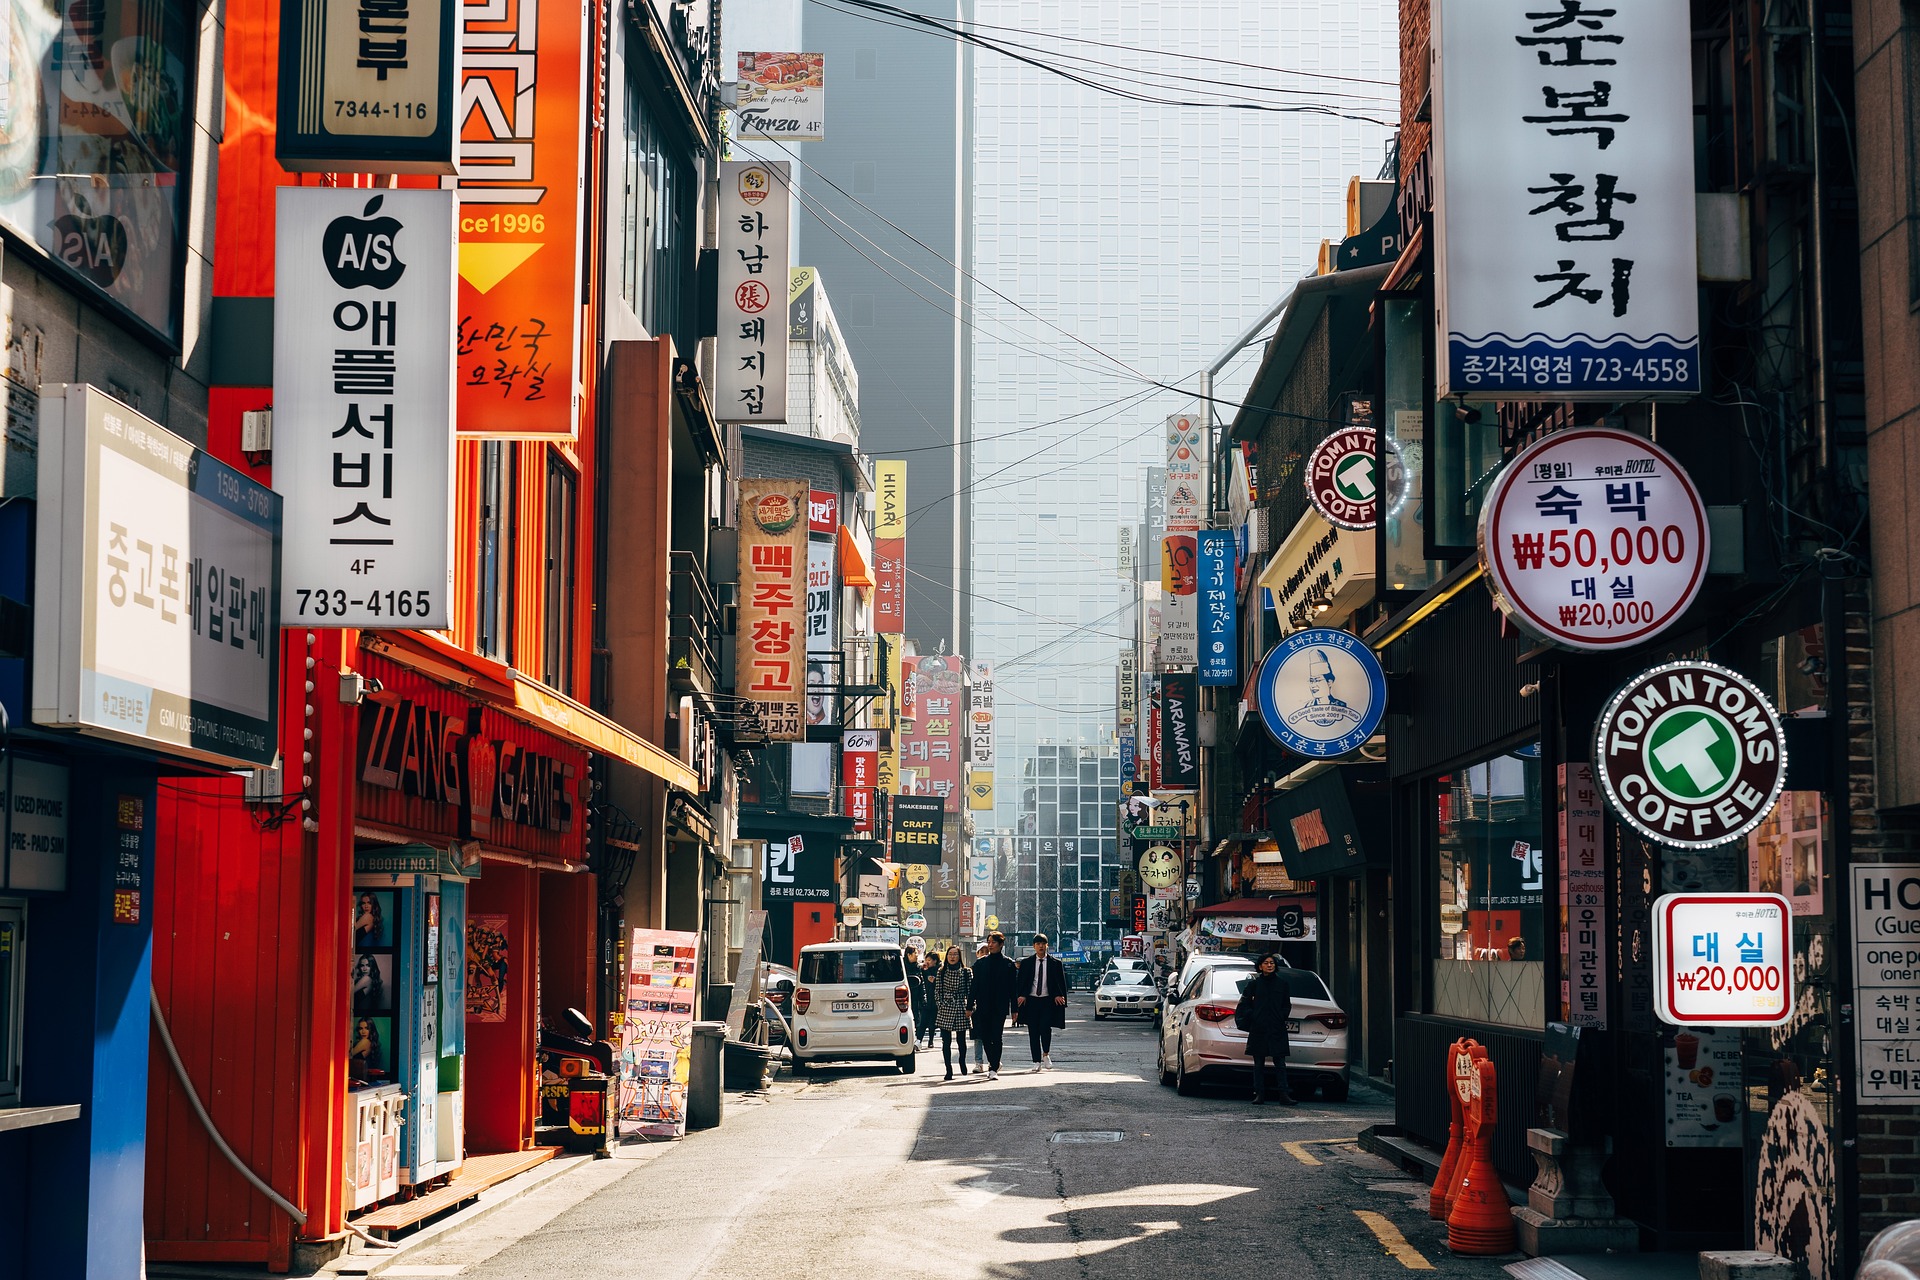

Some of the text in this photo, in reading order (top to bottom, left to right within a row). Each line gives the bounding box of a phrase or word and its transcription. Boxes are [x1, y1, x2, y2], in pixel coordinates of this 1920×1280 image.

[334, 100, 427, 120] 7344-116
[740, 107, 822, 132] Forza 4F
[1515, 0, 1637, 318] 춘복참치
[460, 214, 545, 235] ce1996
[337, 232, 394, 271] A/S
[457, 316, 552, 366] 한민국
[1462, 355, 1689, 385] 종각직영점 723-4558
[329, 299, 397, 546] 애플서비스
[1315, 434, 1361, 481] TOM N
[1534, 458, 1656, 479] [평일] 우미관 HOTEL
[217, 470, 269, 519] 1599 3768
[883, 473, 896, 527] HIKARI
[1176, 506, 1190, 515] 4F
[1511, 524, 1685, 574] ₩50,000
[350, 559, 375, 576] 4F
[296, 589, 431, 618] 733-4165
[750, 545, 795, 692] 맥주창고
[1558, 600, 1654, 629] ₩20,000
[1326, 632, 1355, 650] 전문점
[1210, 658, 1226, 666] 종로점
[1211, 669, 1233, 678] 720-5917
[972, 680, 993, 693] 보쌈
[1121, 659, 1134, 712] 일본유학
[972, 695, 993, 709] 족발
[1298, 708, 1311, 717] Good
[159, 708, 265, 751] GSM USED PHONE PREPAID PHONE
[1165, 681, 1194, 774] WARAWARA
[1610, 673, 1775, 765] TOM N TOMS
[973, 723, 993, 762] 보신탕
[1281, 729, 1367, 755] 이춘복 참치
[499, 740, 576, 834] GAMES
[853, 757, 867, 826] 맛있는 치킨
[14, 794, 35, 814] USED
[36, 799, 63, 818] PHONE
[898, 803, 939, 811] SHAKESBEER
[1619, 773, 1764, 836] COFFEE
[902, 820, 933, 829] CRAFT
[12, 832, 65, 854] PRE PAID SIM
[895, 831, 939, 845] BEER
[369, 857, 408, 871] BOOTH
[410, 857, 436, 871] NO.1
[1140, 865, 1180, 880] 국자비어
[770, 887, 830, 897] 종로 본점 02.734.7788
[1569, 881, 1605, 893] Guesthouse
[1735, 908, 1778, 919] 우미관 HOTEL
[1578, 908, 1599, 1012] 우미관호텔
[1866, 950, 1903, 965] one
[1676, 965, 1780, 995] ₩20,000
[1880, 968, 1911, 981] (one
[852, 1002, 870, 1010] 8126
[1875, 994, 1909, 1012] 숙박
[1876, 1017, 1909, 1034] 대실
[1713, 1051, 1726, 1059] ICE
[1882, 1048, 1920, 1063] TEL.
[1676, 1092, 1693, 1101] TEA
